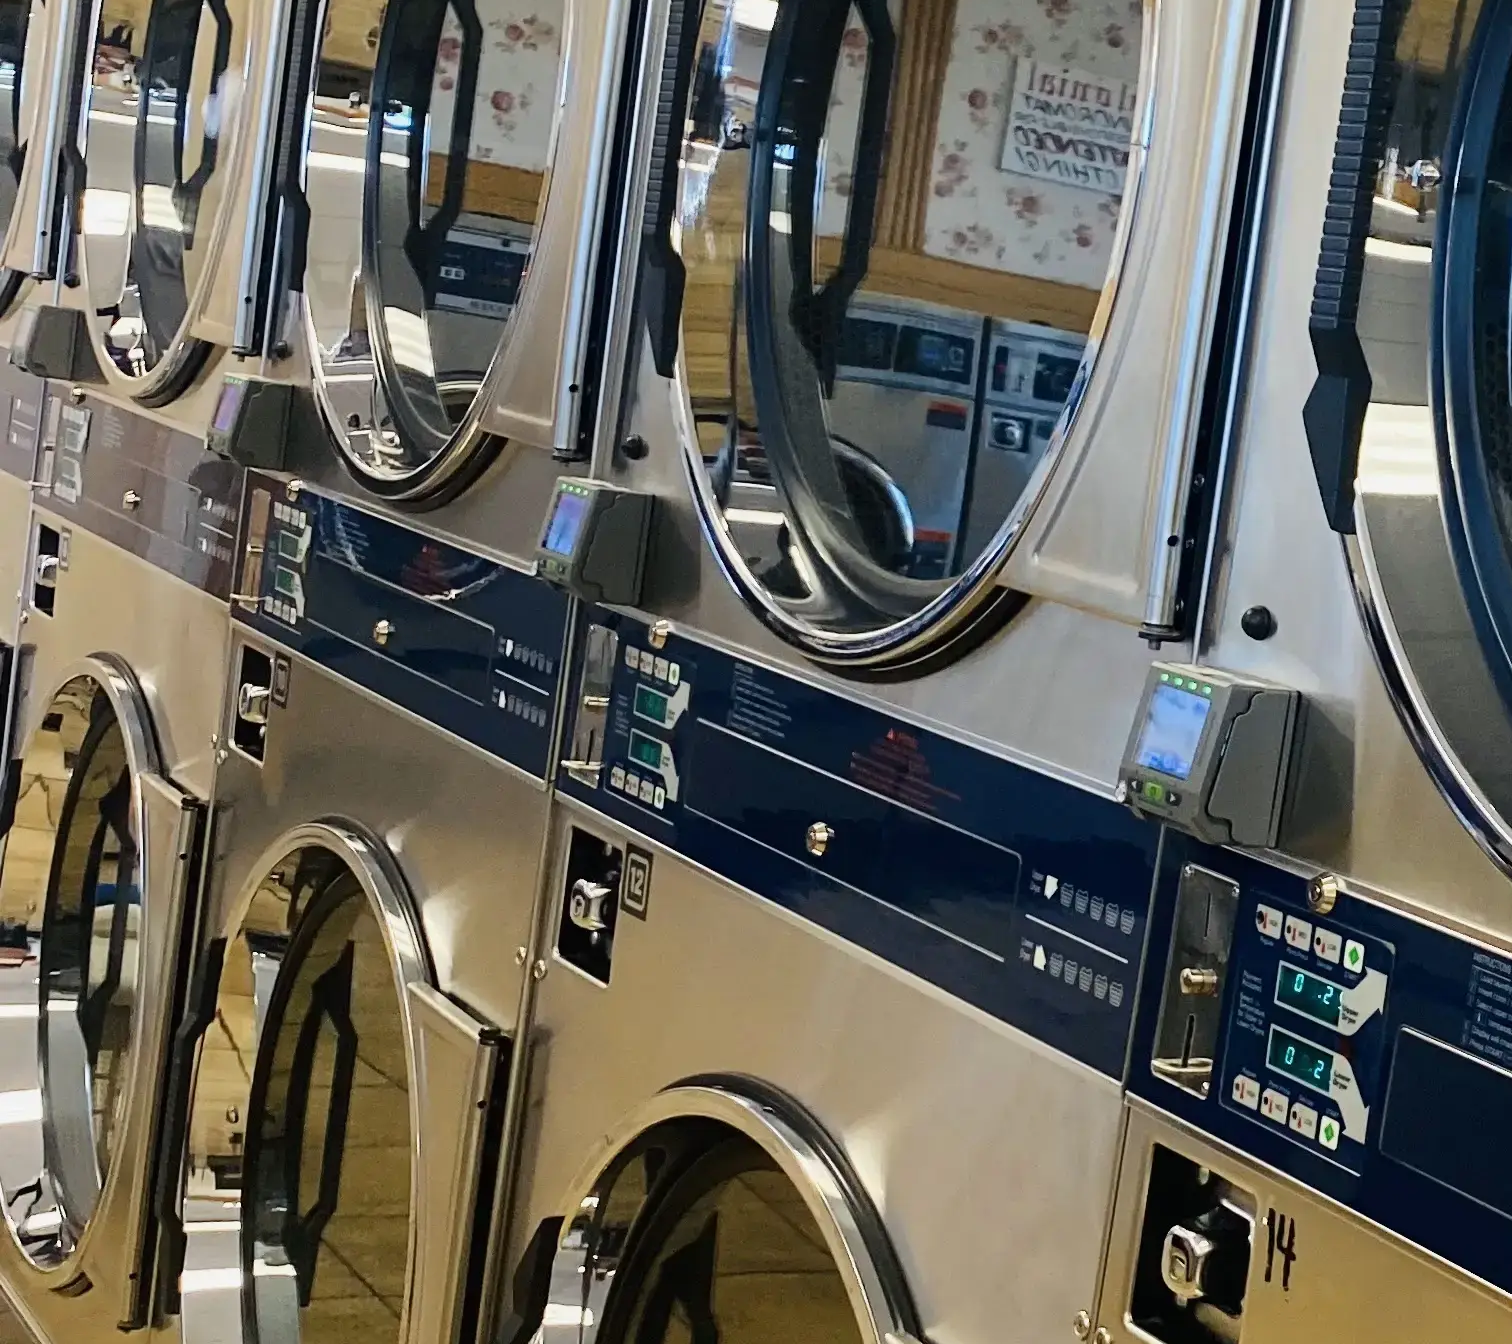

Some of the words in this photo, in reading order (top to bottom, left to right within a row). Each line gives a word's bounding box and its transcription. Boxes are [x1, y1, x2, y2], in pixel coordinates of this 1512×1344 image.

[631, 866, 644, 896] 12
[1293, 973, 1304, 993] 0
[1285, 1046, 1296, 1065] 0
[1264, 1207, 1297, 1292] 14
